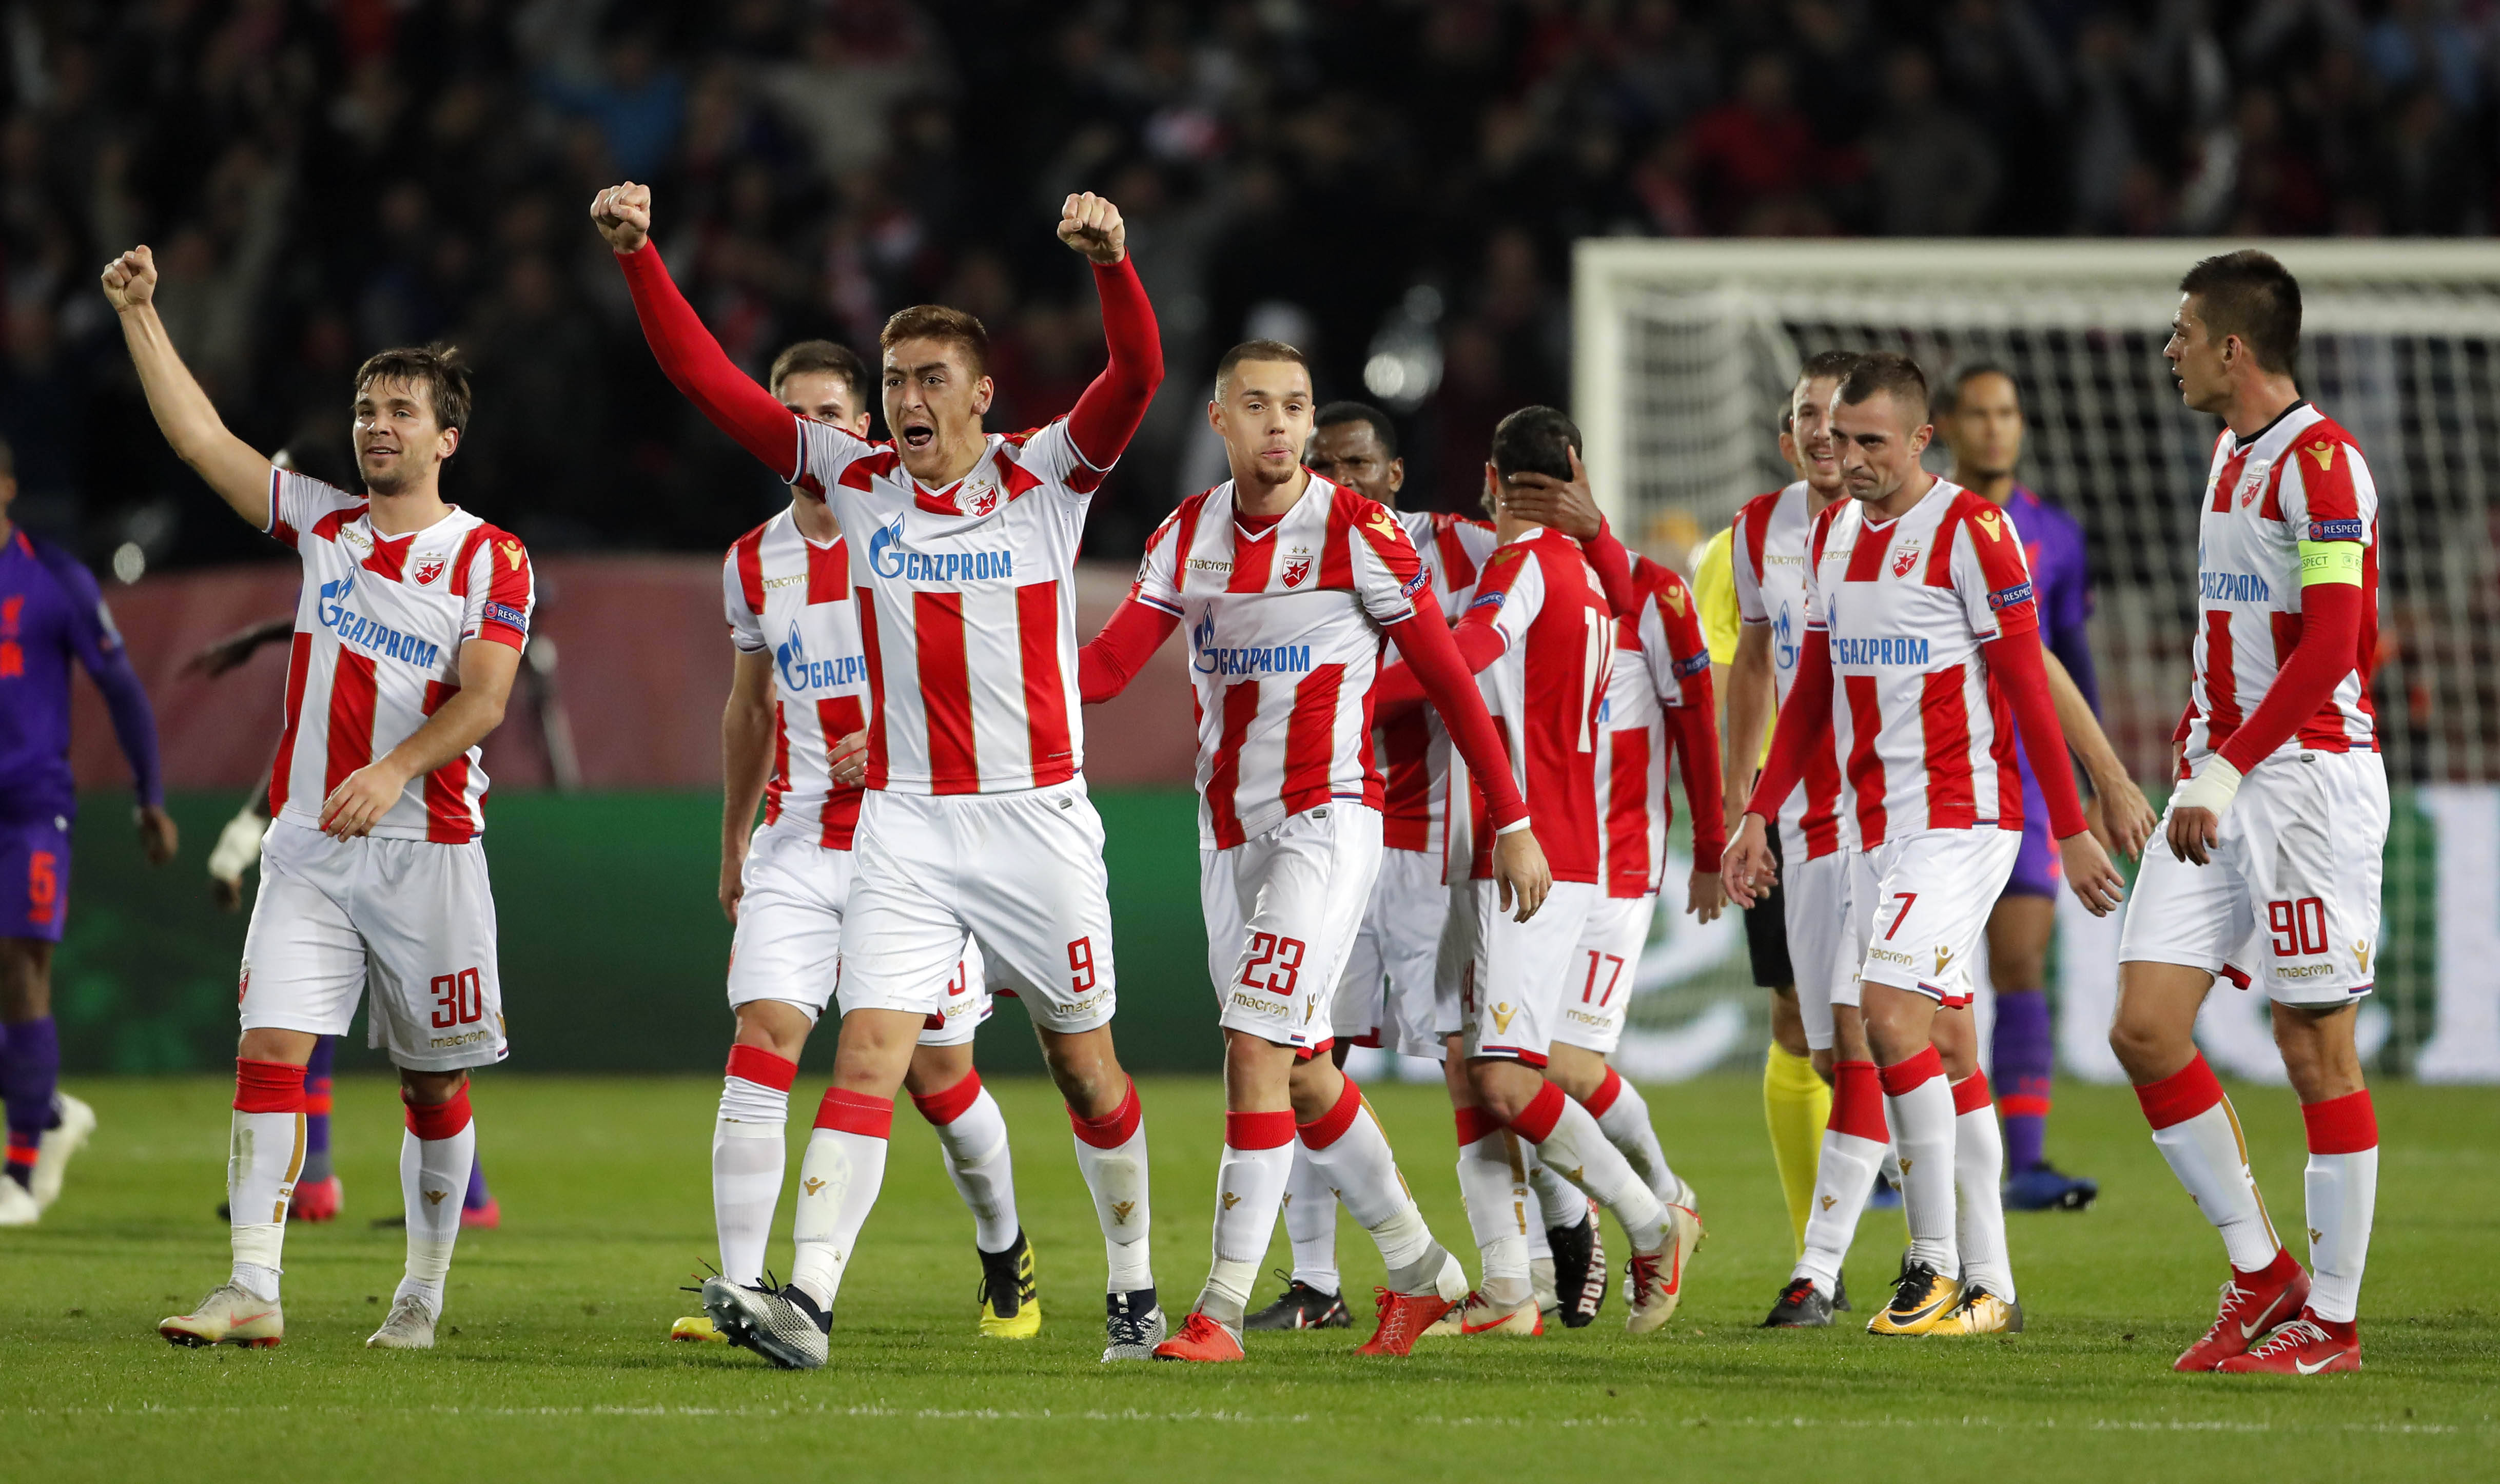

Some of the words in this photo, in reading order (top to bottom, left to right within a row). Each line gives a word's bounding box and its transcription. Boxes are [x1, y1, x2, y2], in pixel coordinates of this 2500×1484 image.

[2323, 524, 2361, 534] RESPECT
[907, 550, 1012, 581] GAZPROM
[1185, 558, 1232, 572] macron
[338, 611, 439, 669] GAZPROM
[1839, 639, 1929, 665] GAZPROM
[1219, 645, 1310, 675] GAZPROM
[1884, 892, 1918, 941] 7
[2268, 896, 2329, 957] 90
[1067, 936, 1096, 993] 9
[1240, 931, 1306, 997] 23
[1581, 949, 1625, 1008] 17
[2277, 963, 2333, 978] macron
[431, 967, 482, 1028] 30
[1060, 989, 1109, 1013] macron
[1233, 991, 1290, 1018] macron
[431, 1029, 487, 1048] macron
